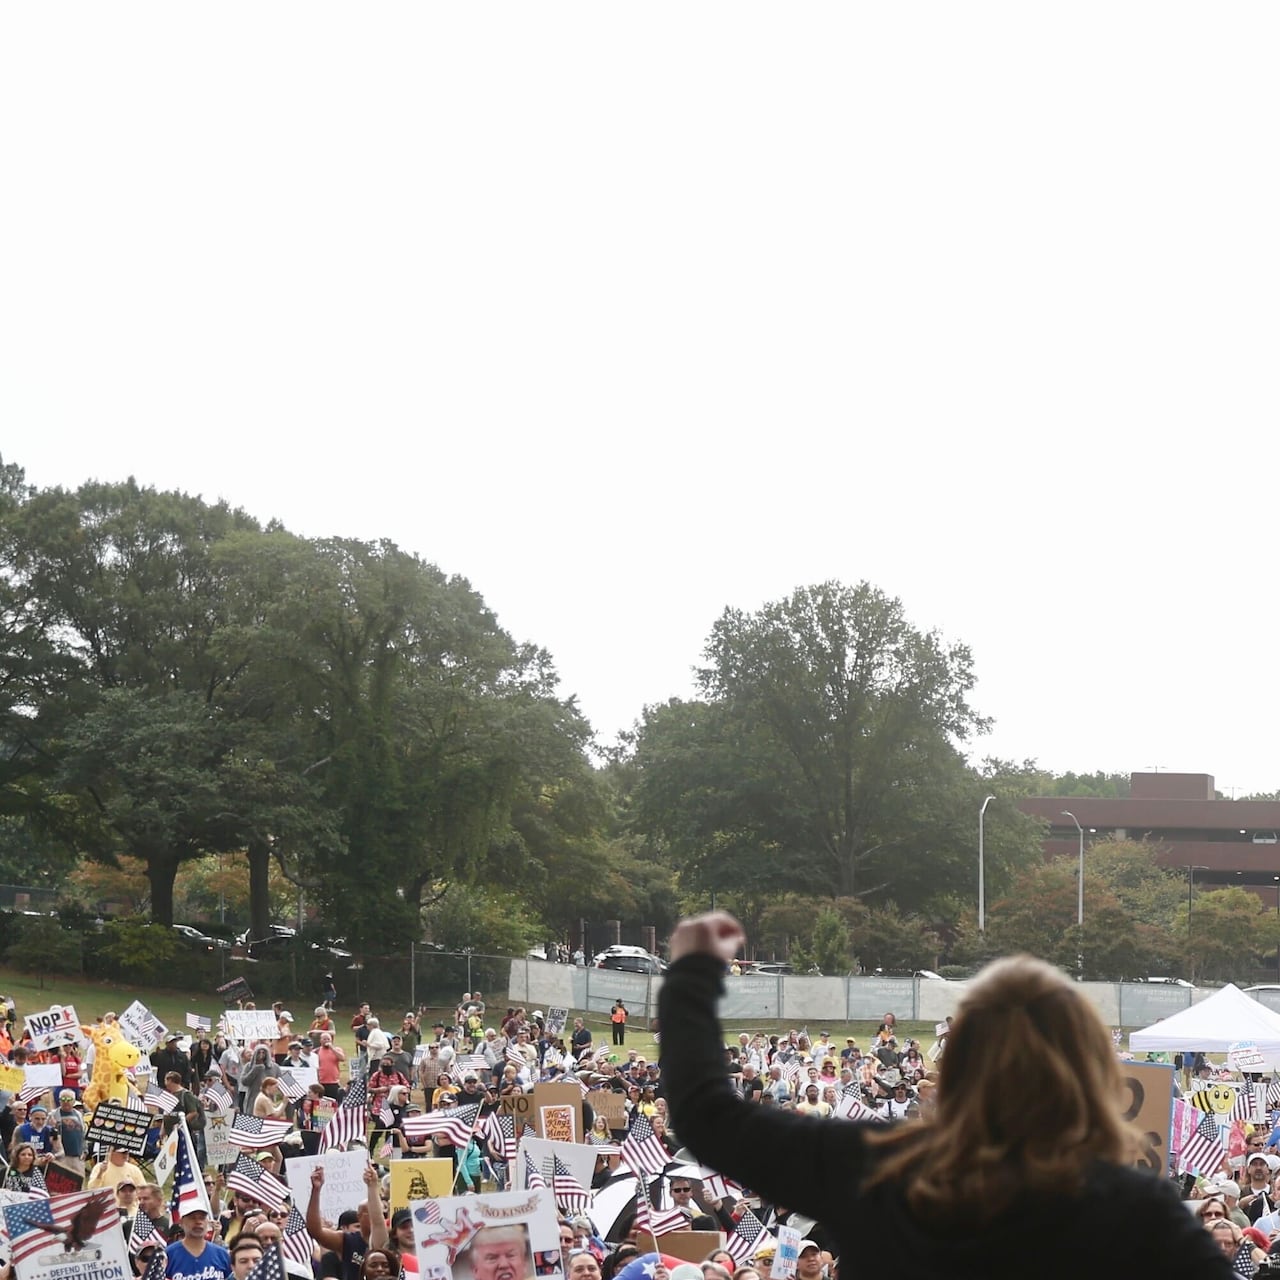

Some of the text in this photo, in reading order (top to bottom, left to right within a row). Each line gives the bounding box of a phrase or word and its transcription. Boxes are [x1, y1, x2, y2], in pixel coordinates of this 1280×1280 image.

[503, 1097, 529, 1114] NO
[486, 1204, 534, 1217] NO KINGS
[50, 1262, 98, 1277] DEFEND THE
